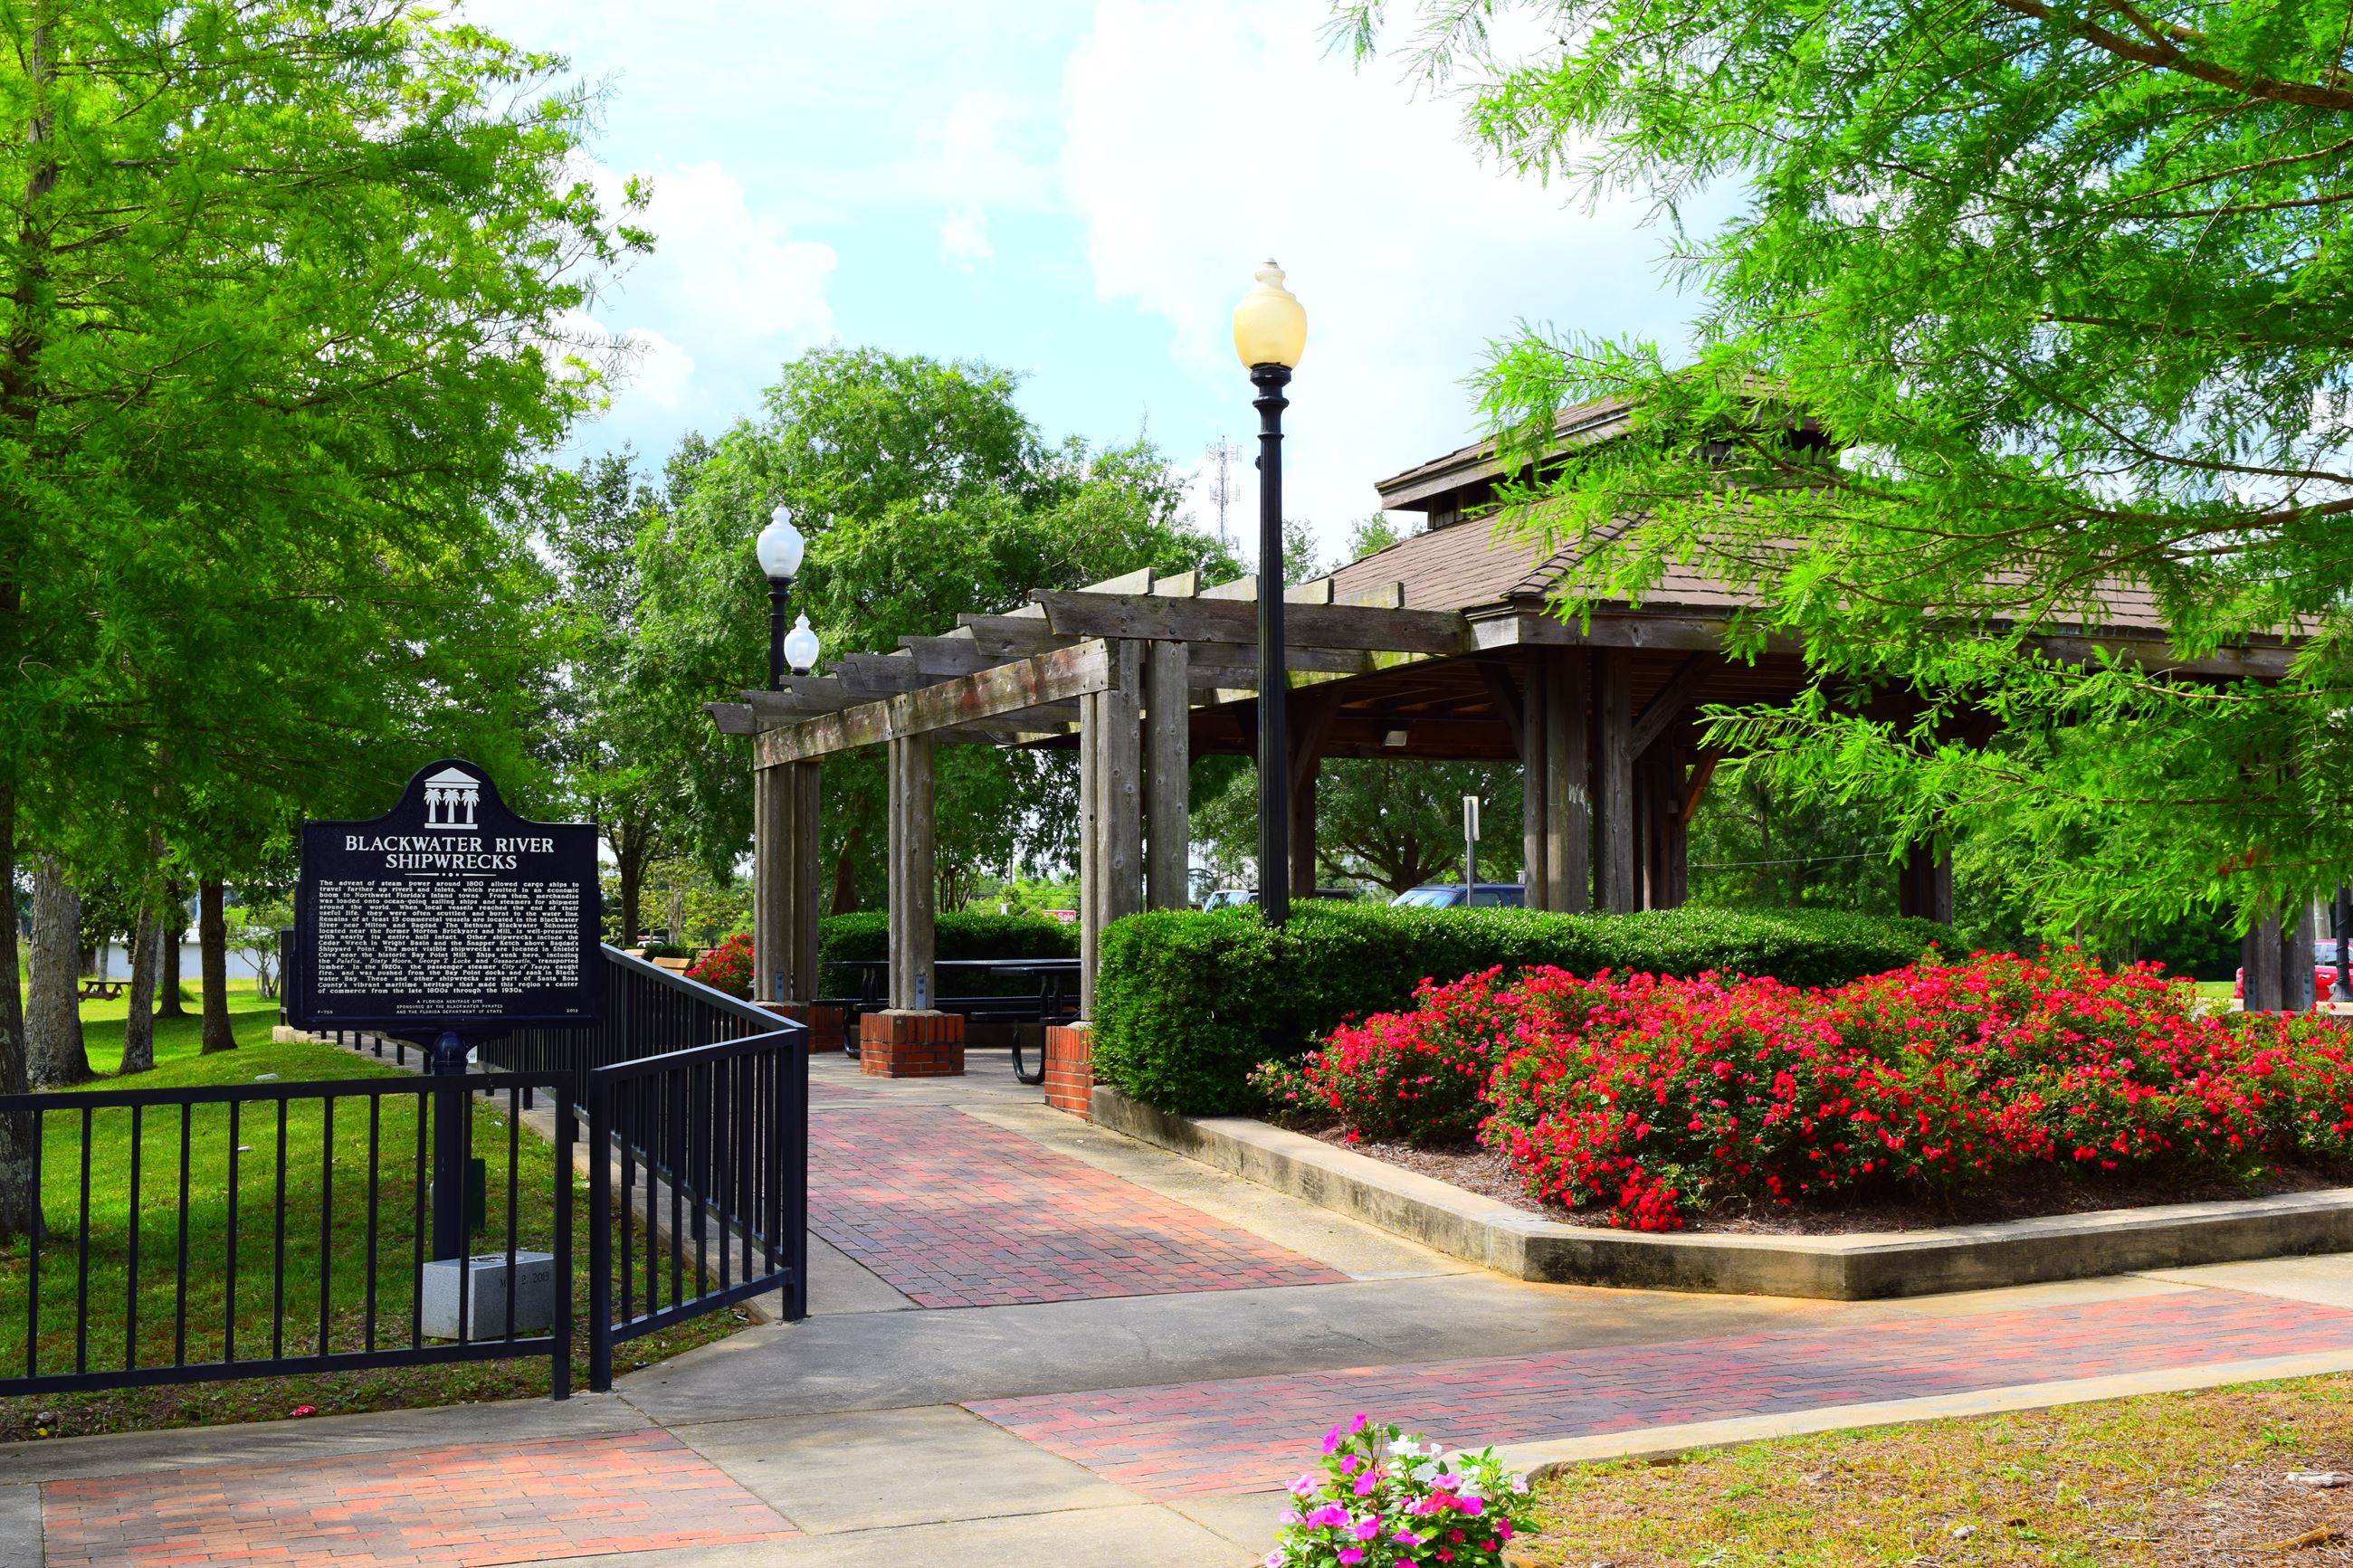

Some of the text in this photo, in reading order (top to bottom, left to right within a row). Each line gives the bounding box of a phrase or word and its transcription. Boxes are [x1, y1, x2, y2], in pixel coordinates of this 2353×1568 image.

[345, 835, 554, 853] BLACKWATER RIVER
[386, 854, 517, 869] SHIPWRECKS
[1058, 912, 1074, 921] Sale
